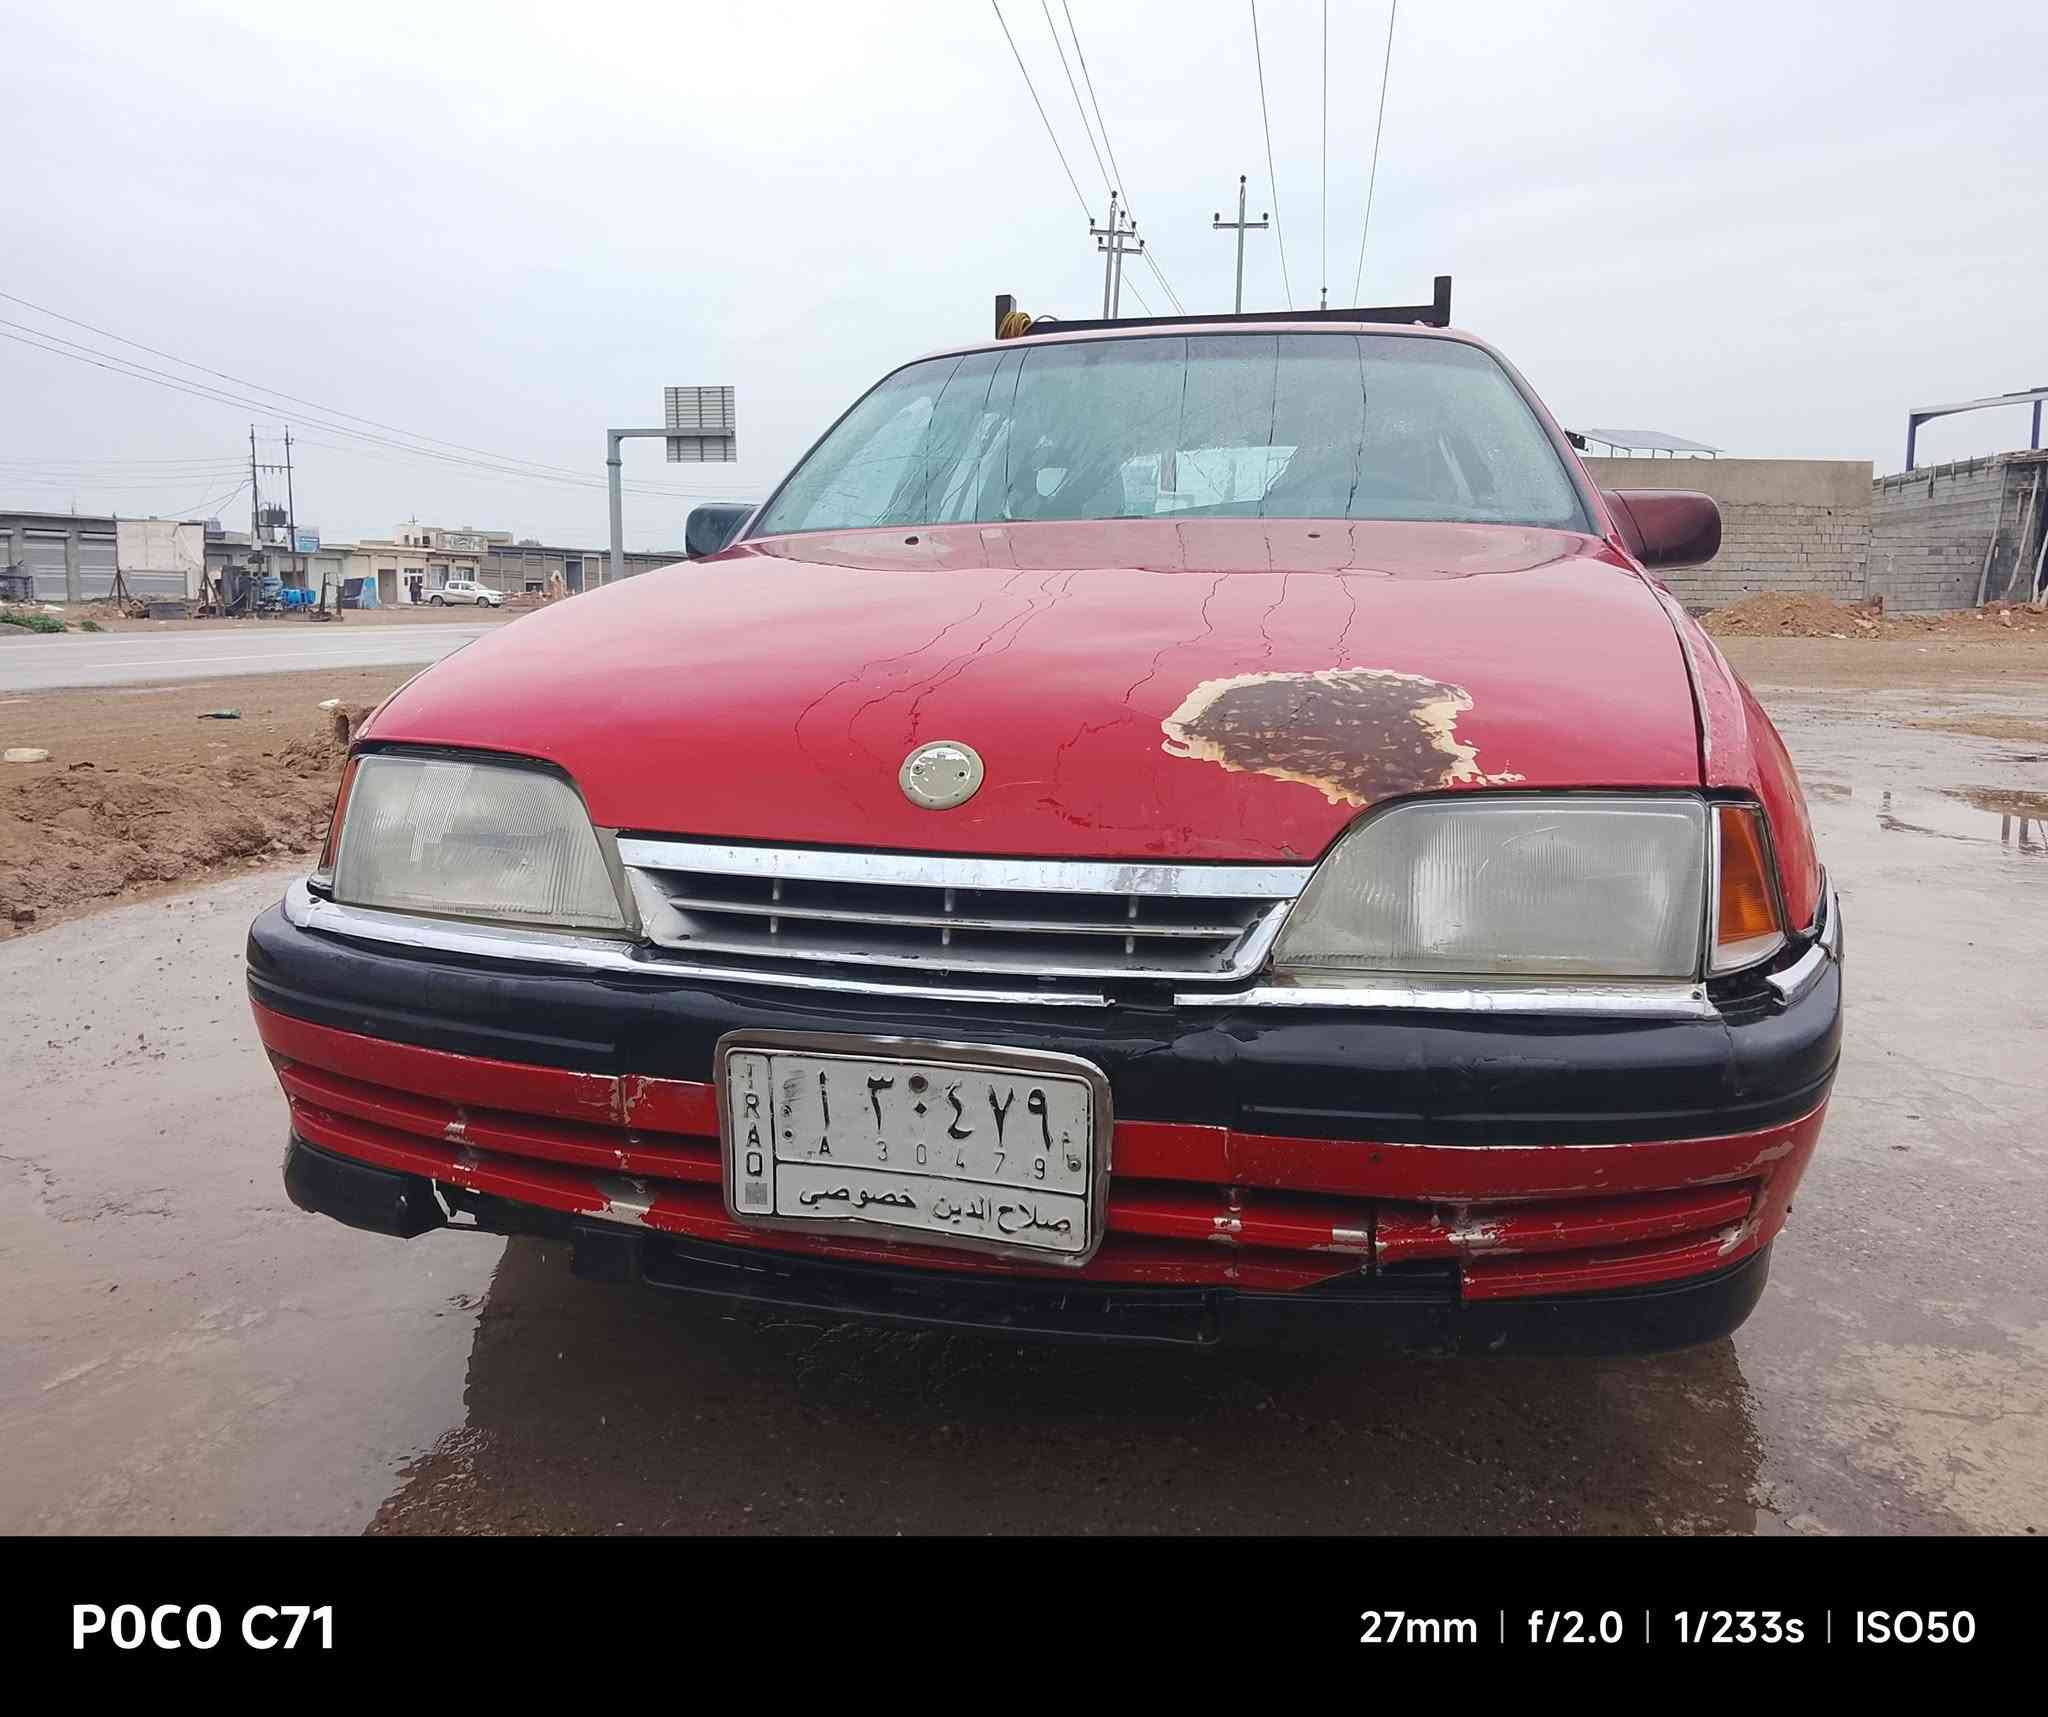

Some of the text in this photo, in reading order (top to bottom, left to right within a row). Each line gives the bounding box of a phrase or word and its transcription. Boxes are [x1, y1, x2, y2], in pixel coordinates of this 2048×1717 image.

[799, 1187, 1072, 1234] صلاح الدين خصوصي
